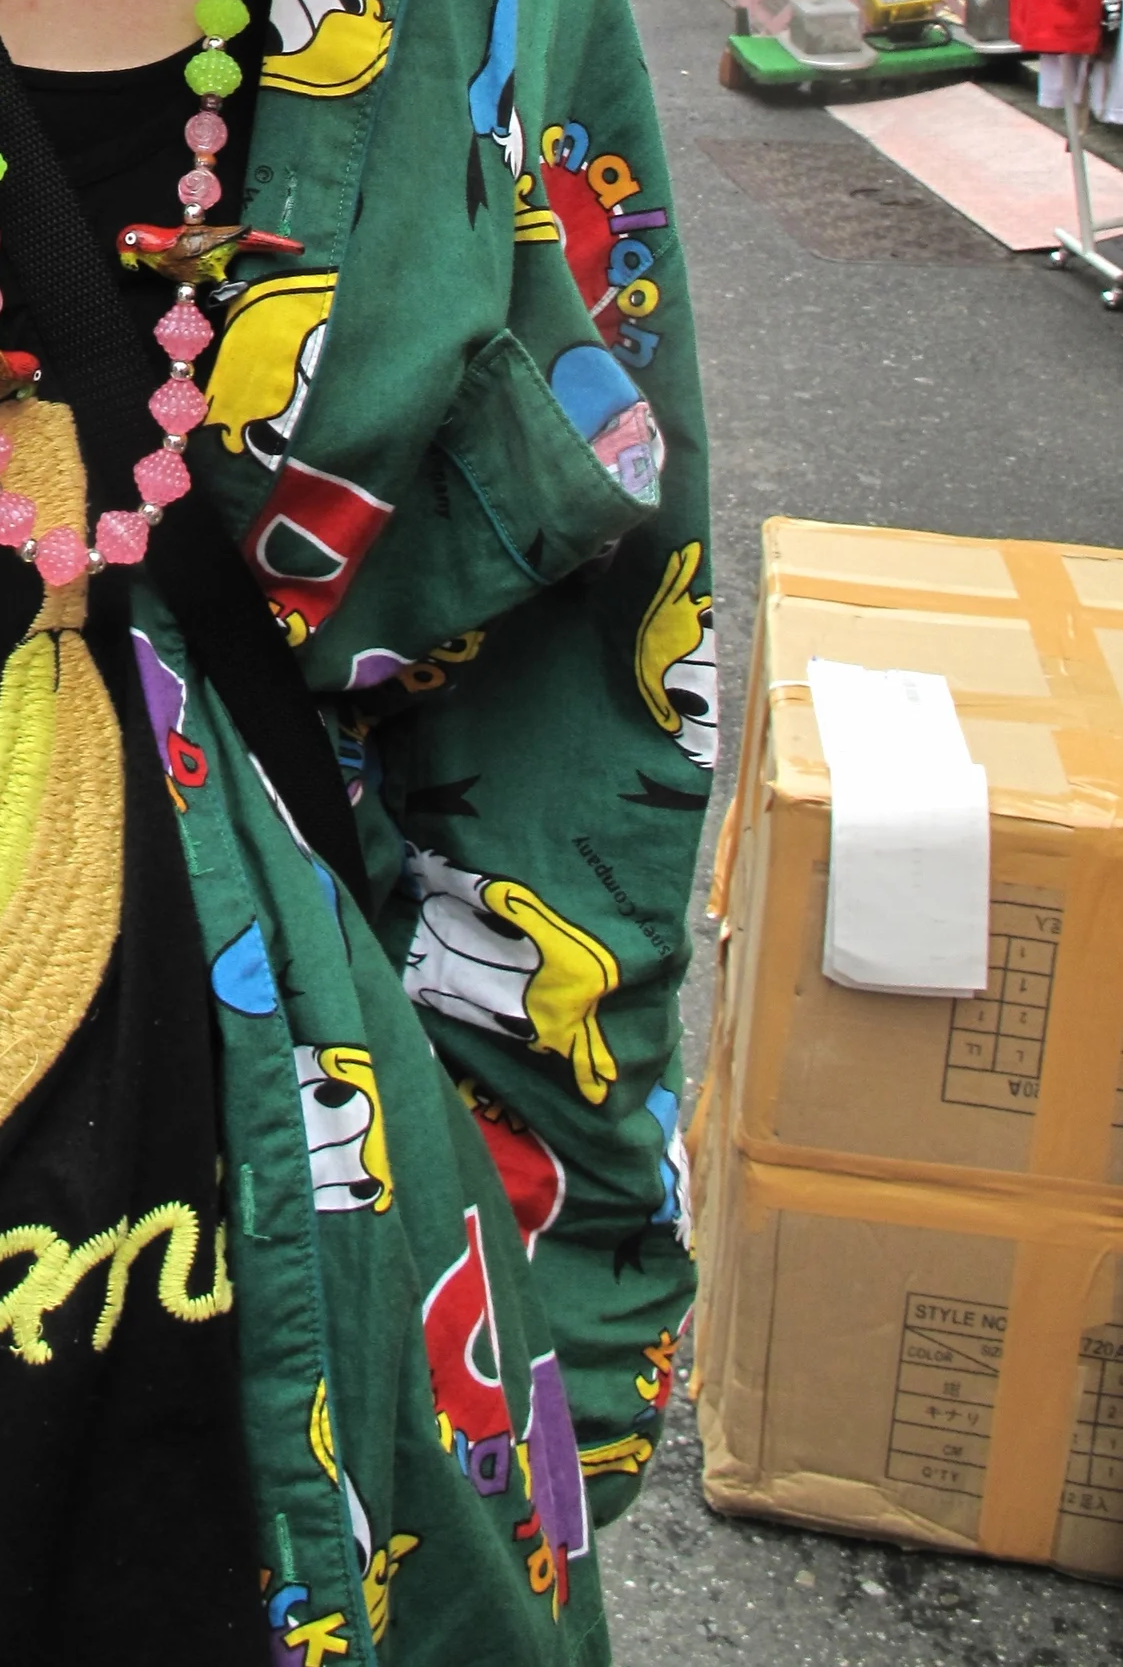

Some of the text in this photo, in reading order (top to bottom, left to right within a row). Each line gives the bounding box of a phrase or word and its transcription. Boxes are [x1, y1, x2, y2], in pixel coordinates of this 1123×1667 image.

[571, 836, 636, 917] Company
[914, 1304, 976, 1327] STYLE
[906, 1345, 955, 1363] COLOR
[980, 1344, 1004, 1359] SIZ
